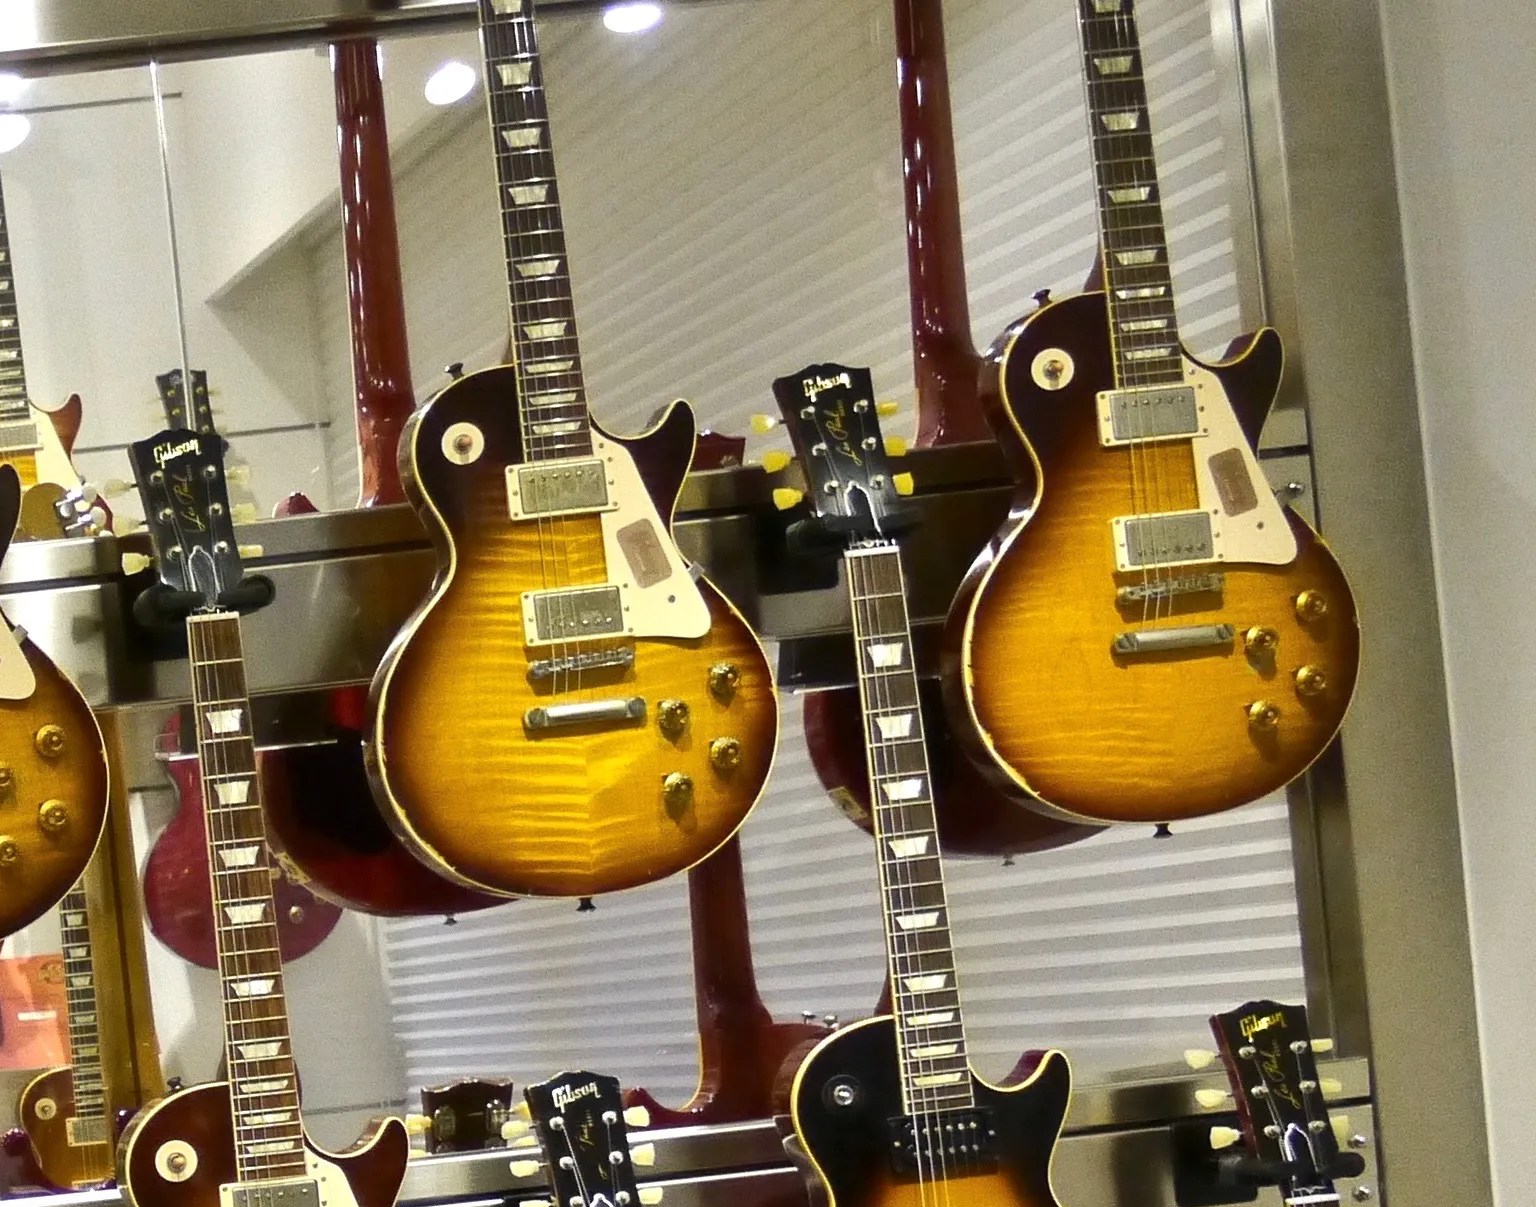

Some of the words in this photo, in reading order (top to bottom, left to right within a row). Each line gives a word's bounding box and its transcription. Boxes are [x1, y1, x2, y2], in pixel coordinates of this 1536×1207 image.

[802, 372, 852, 402] Gibson
[153, 439, 202, 469] Gibson
[1239, 1010, 1287, 1042] Gibson
[551, 1082, 601, 1113] Gibson
